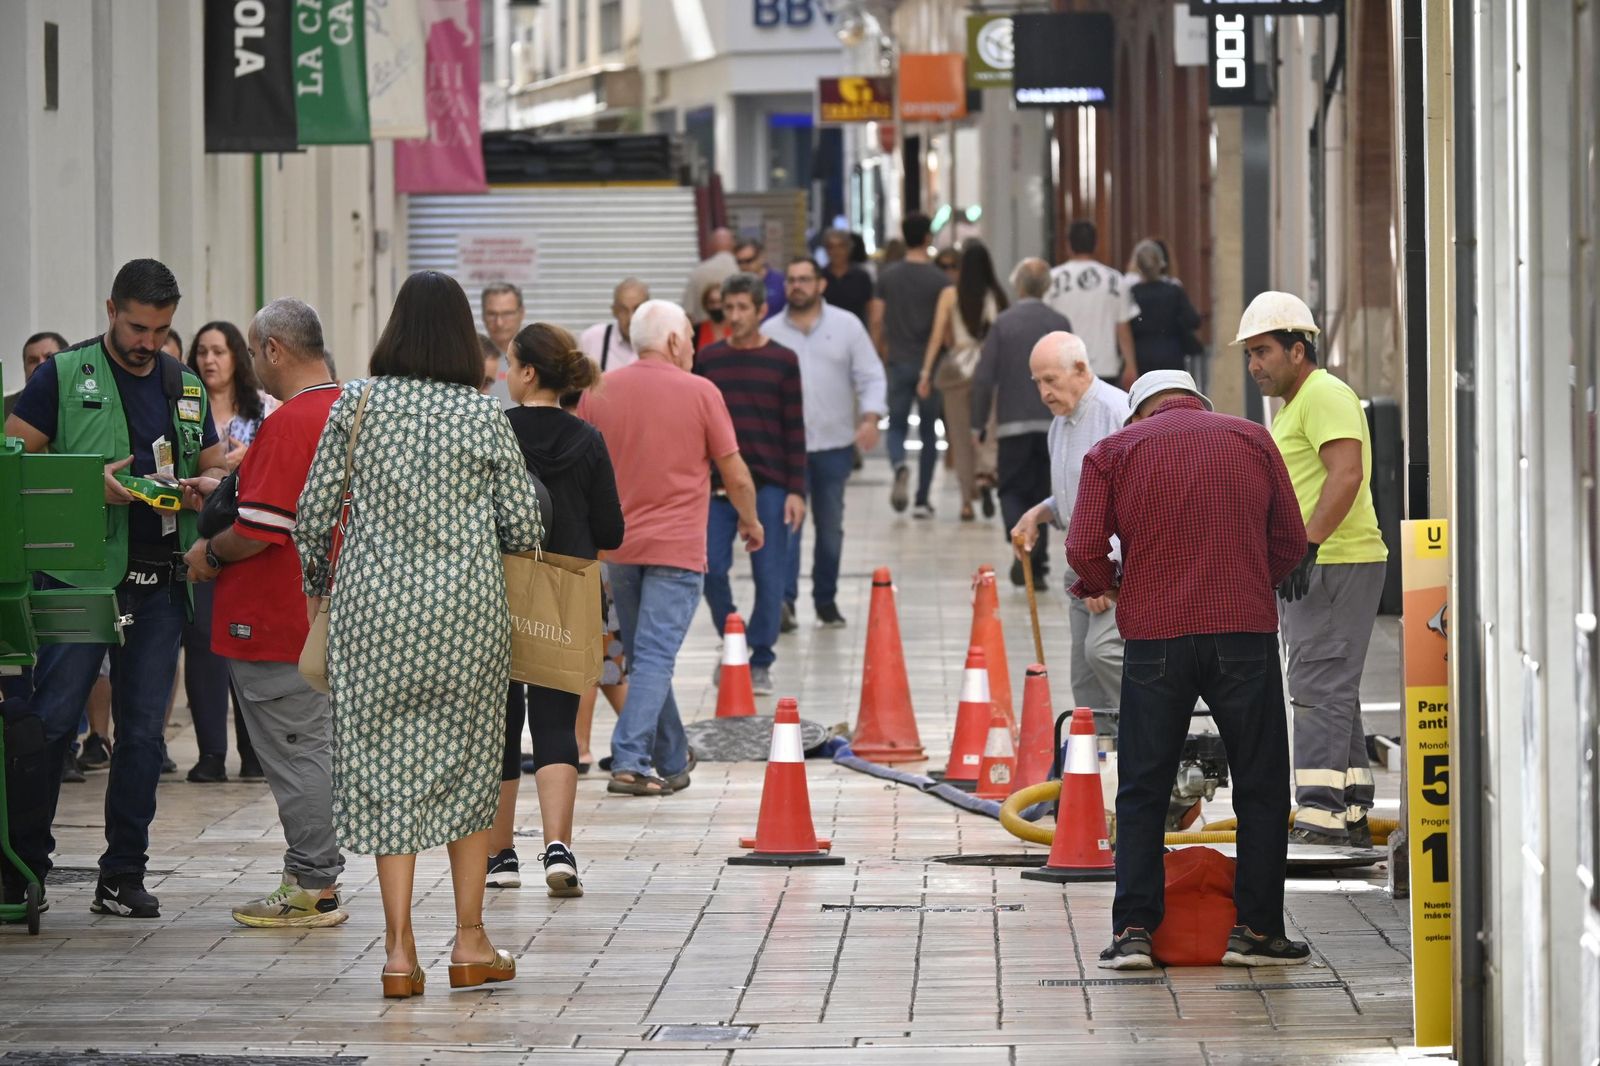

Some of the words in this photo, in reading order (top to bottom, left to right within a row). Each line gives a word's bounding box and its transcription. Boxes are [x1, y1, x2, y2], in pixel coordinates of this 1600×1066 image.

[297, 46, 324, 97] LA
[184, 387, 199, 396] NCE
[1428, 527, 1441, 543] U
[126, 571, 158, 584] FILA
[1418, 716, 1448, 729] anti
[1419, 741, 1449, 750] Monof
[1422, 755, 1450, 806] 5
[1422, 832, 1449, 883] 1
